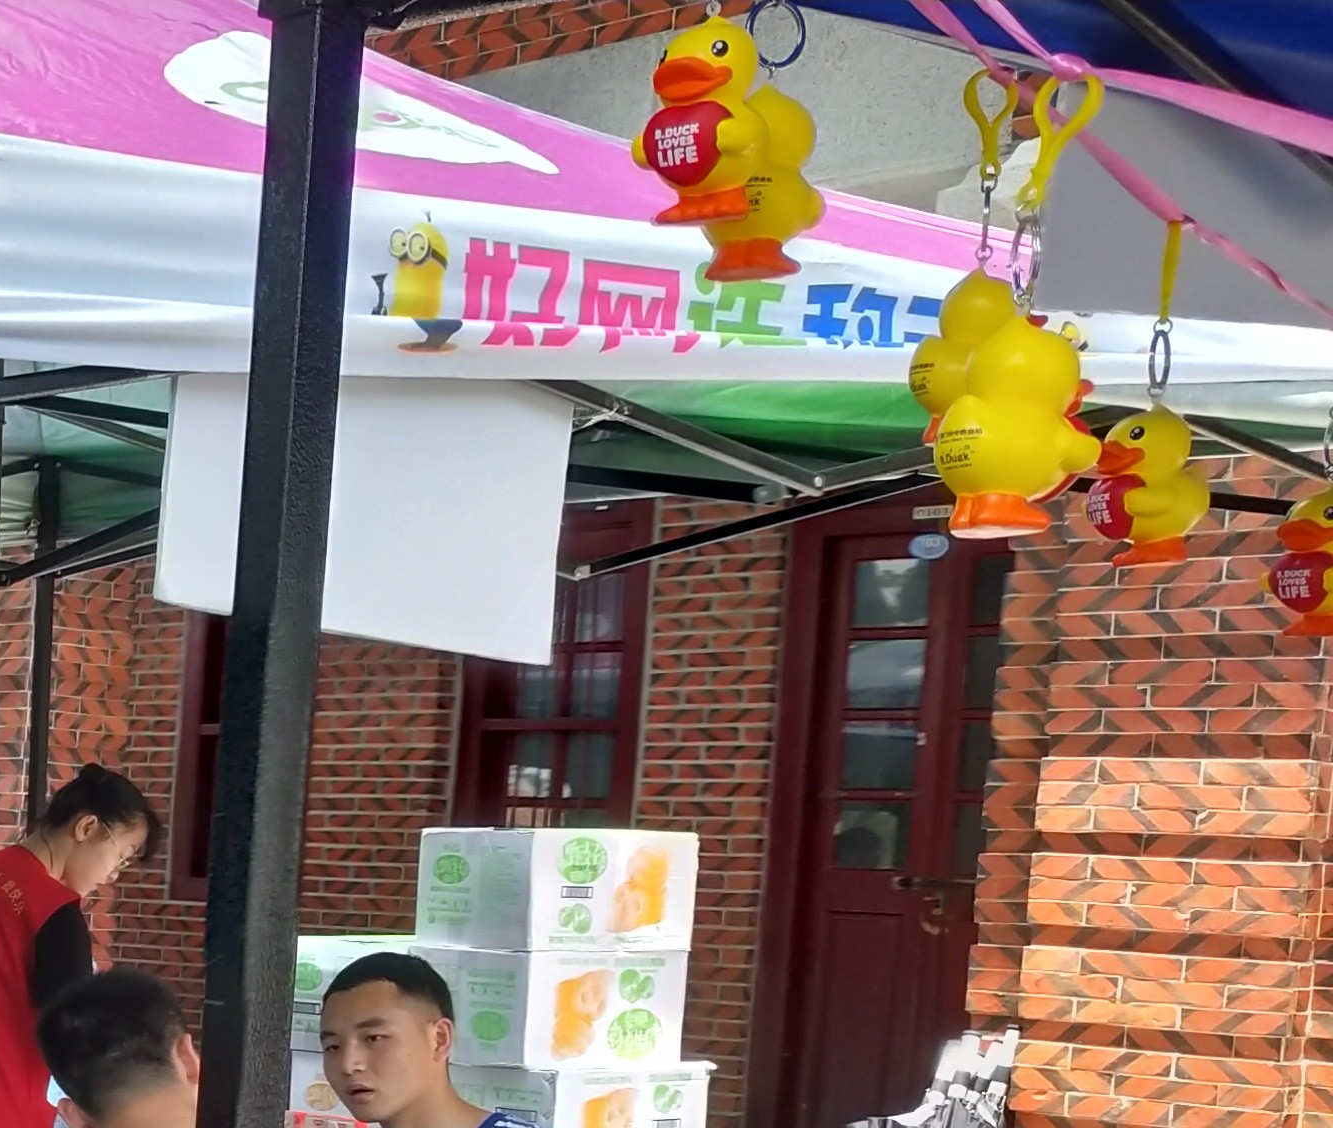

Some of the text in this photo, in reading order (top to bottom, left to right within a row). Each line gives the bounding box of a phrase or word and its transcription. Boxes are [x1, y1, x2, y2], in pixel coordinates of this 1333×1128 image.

[654, 122, 700, 140] B.DUCK
[658, 135, 694, 150] LOVES
[657, 145, 699, 168] LIFE
[1278, 585, 1311, 599] LIFE
